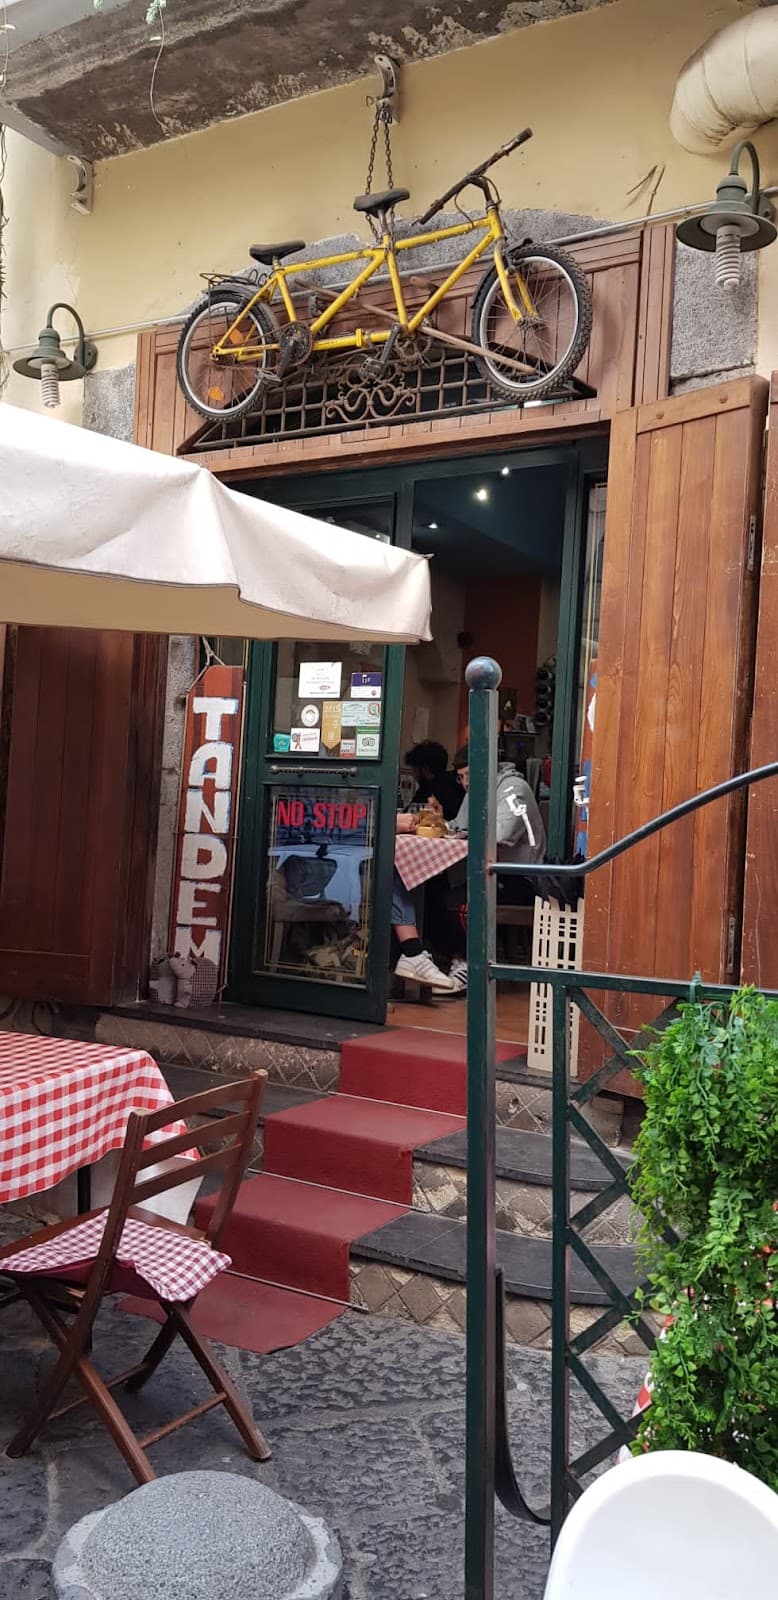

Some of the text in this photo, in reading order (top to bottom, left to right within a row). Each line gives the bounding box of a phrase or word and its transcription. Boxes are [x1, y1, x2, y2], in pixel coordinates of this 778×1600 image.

[176, 697, 239, 968] TANDEM
[277, 800, 367, 831] NO STOP
